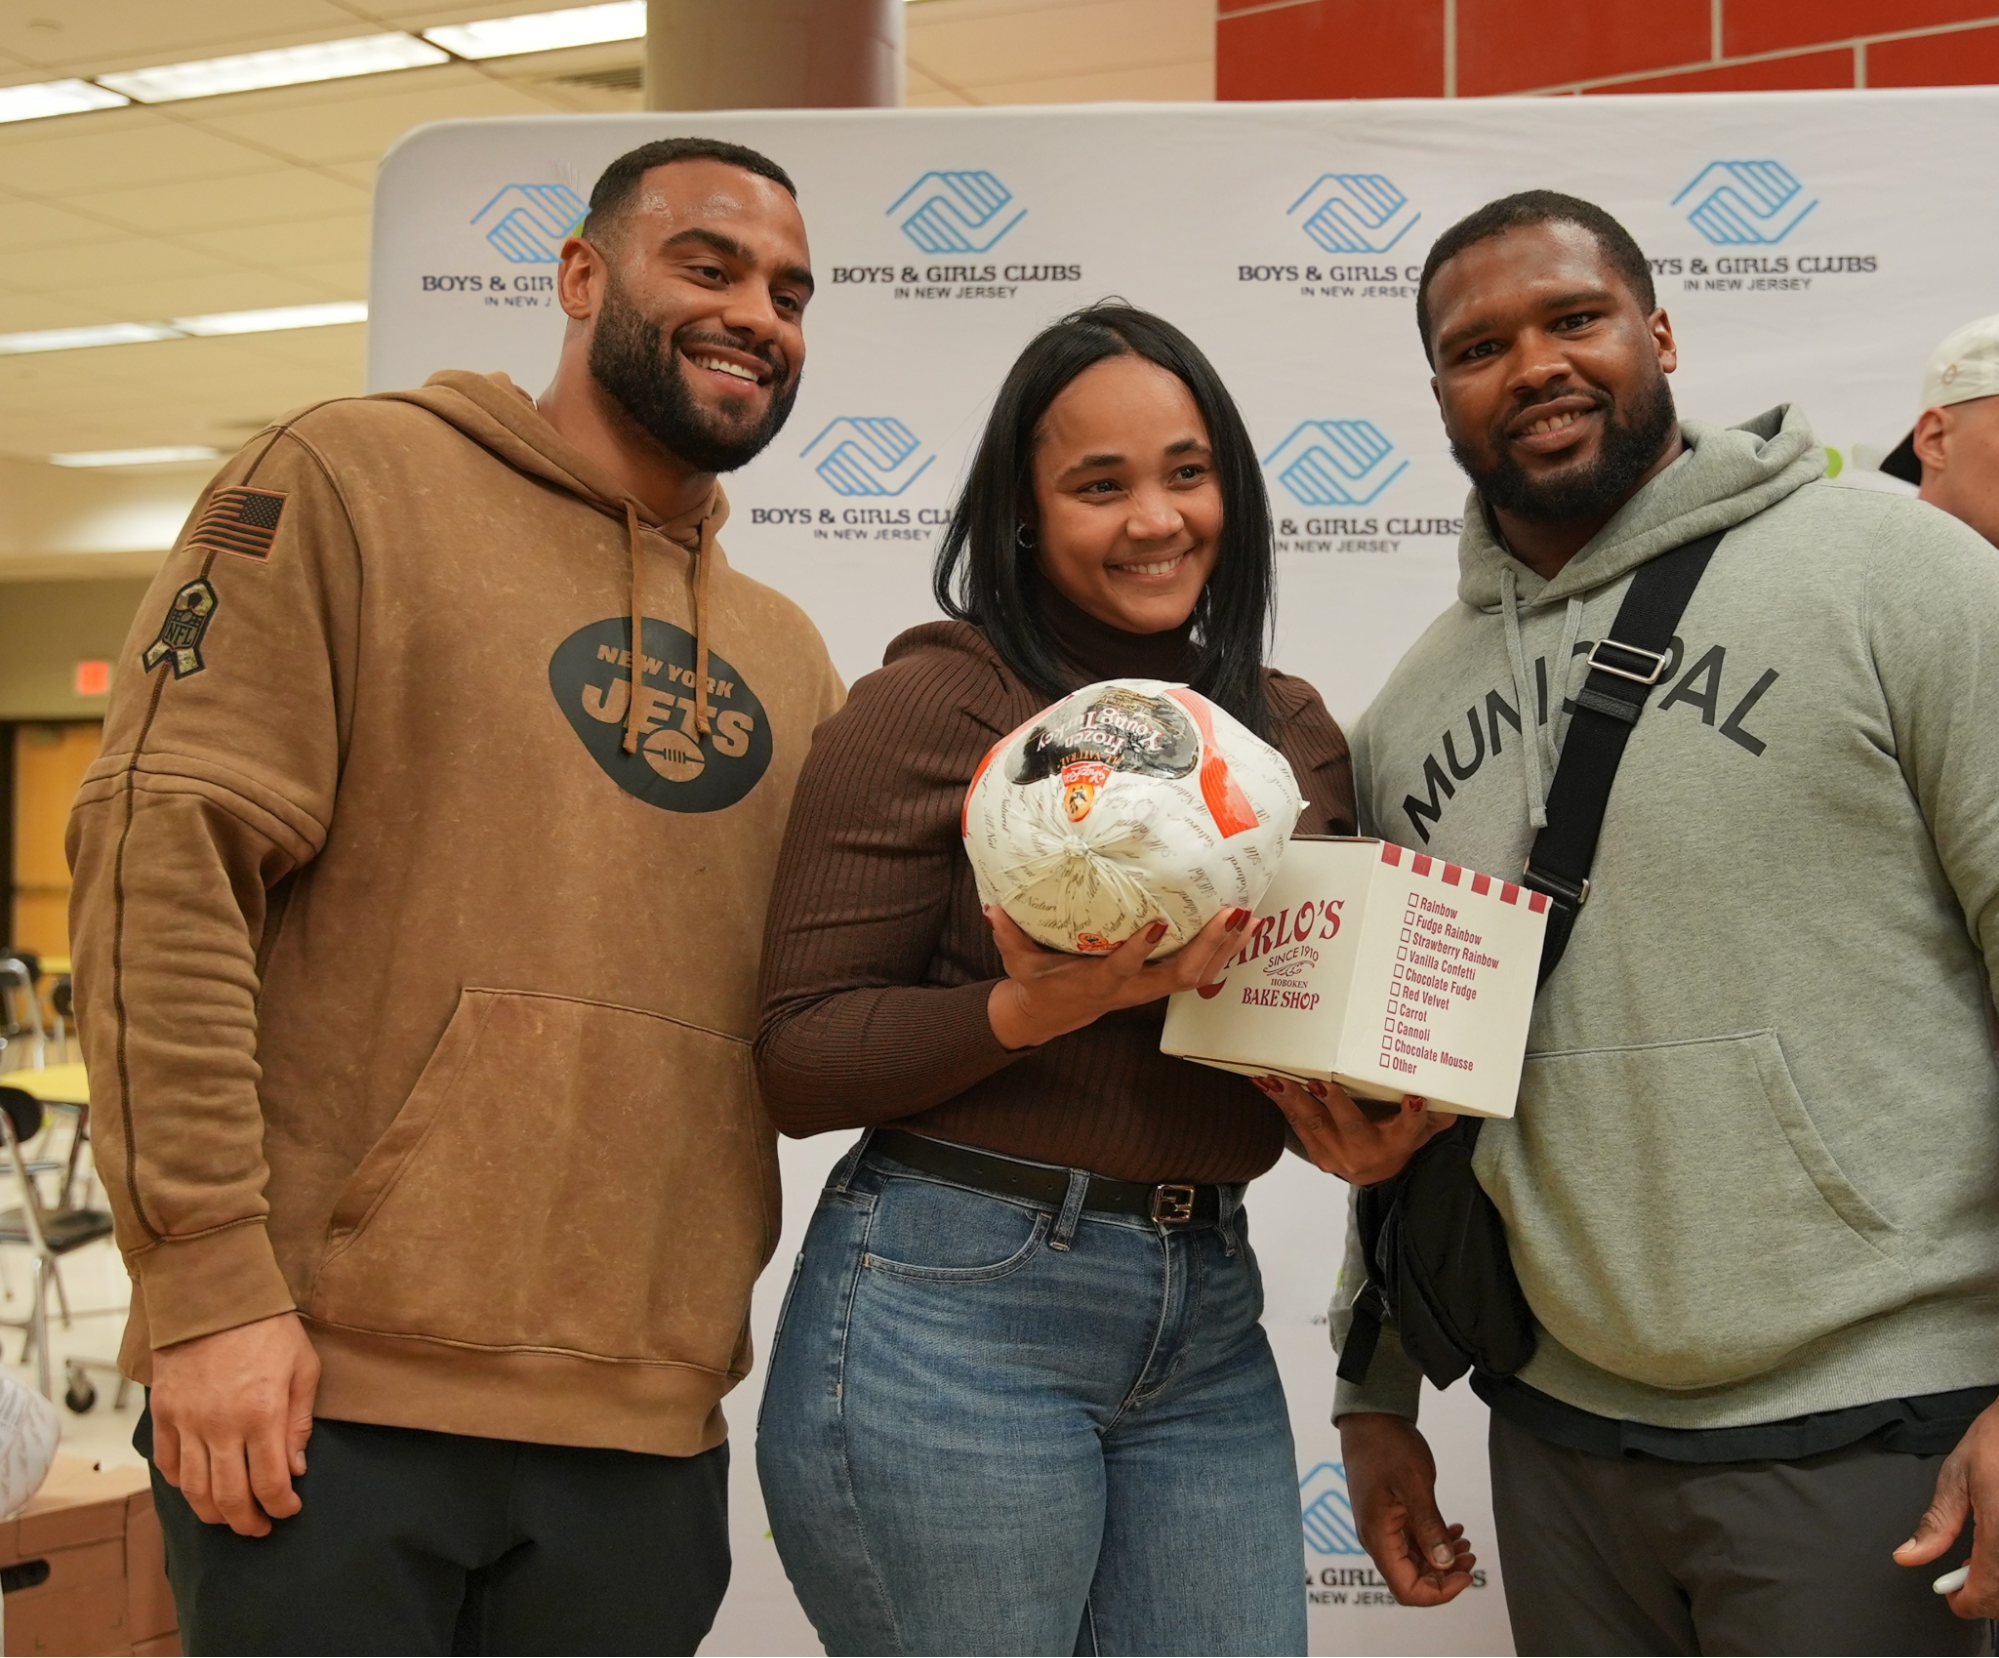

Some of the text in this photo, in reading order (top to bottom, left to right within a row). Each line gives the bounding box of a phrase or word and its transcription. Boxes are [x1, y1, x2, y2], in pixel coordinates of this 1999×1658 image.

[832, 264, 1082, 284] BOYS & GIRLS CLUBS
[1238, 265, 1300, 282] BOYS
[1305, 266, 1322, 282] &
[1330, 265, 1398, 282] GIRLS
[1648, 256, 1877, 275] YS & GIRLS CLUBS
[421, 275, 554, 292] BOYS & GIR
[895, 286, 1018, 299] IN NEW JERSEY
[1300, 286, 1418, 298] IN NEW JERSEY
[1683, 278, 1812, 291] IN NEW JERSEY
[484, 296, 499, 307] IN
[504, 296, 539, 307] NEW
[751, 508, 812, 525] BOYS
[818, 508, 836, 525] &
[843, 508, 911, 525] GIRLS
[814, 529, 932, 541] IN NEW JERSEY
[1280, 518, 1464, 536] & GIRLS CLUBS
[1294, 540, 1332, 553] NEW
[1337, 540, 1401, 553] JERSEY
[165, 622, 194, 645] NFL
[597, 644, 663, 676] NEW
[581, 677, 754, 757] JETS
[1036, 708, 1162, 753] Young Turkey
[1065, 731, 1125, 756] Frozen
[1420, 897, 1458, 919] Rainbow
[1416, 914, 1482, 945] Fudge Rainbow
[1268, 945, 1319, 968] SINCE 1910
[1412, 932, 1500, 969] Strawberry Rainbow
[1409, 949, 1476, 981] Vanilla Confetti
[1270, 978, 1308, 989] HOBOKEN
[1405, 967, 1477, 1001] Chocolate Fudge
[1241, 987, 1320, 1010] BAKE SHOP
[1402, 985, 1450, 1011] Red Velvet
[1399, 1003, 1428, 1023] Carrot
[1397, 1021, 1431, 1042] Cannoli
[1394, 1038, 1474, 1072] Chocolate Mousse
[1392, 1056, 1417, 1075] Other
[1321, 1567, 1387, 1586] GIRL
[1309, 1591, 1396, 1605] NEW JERS
